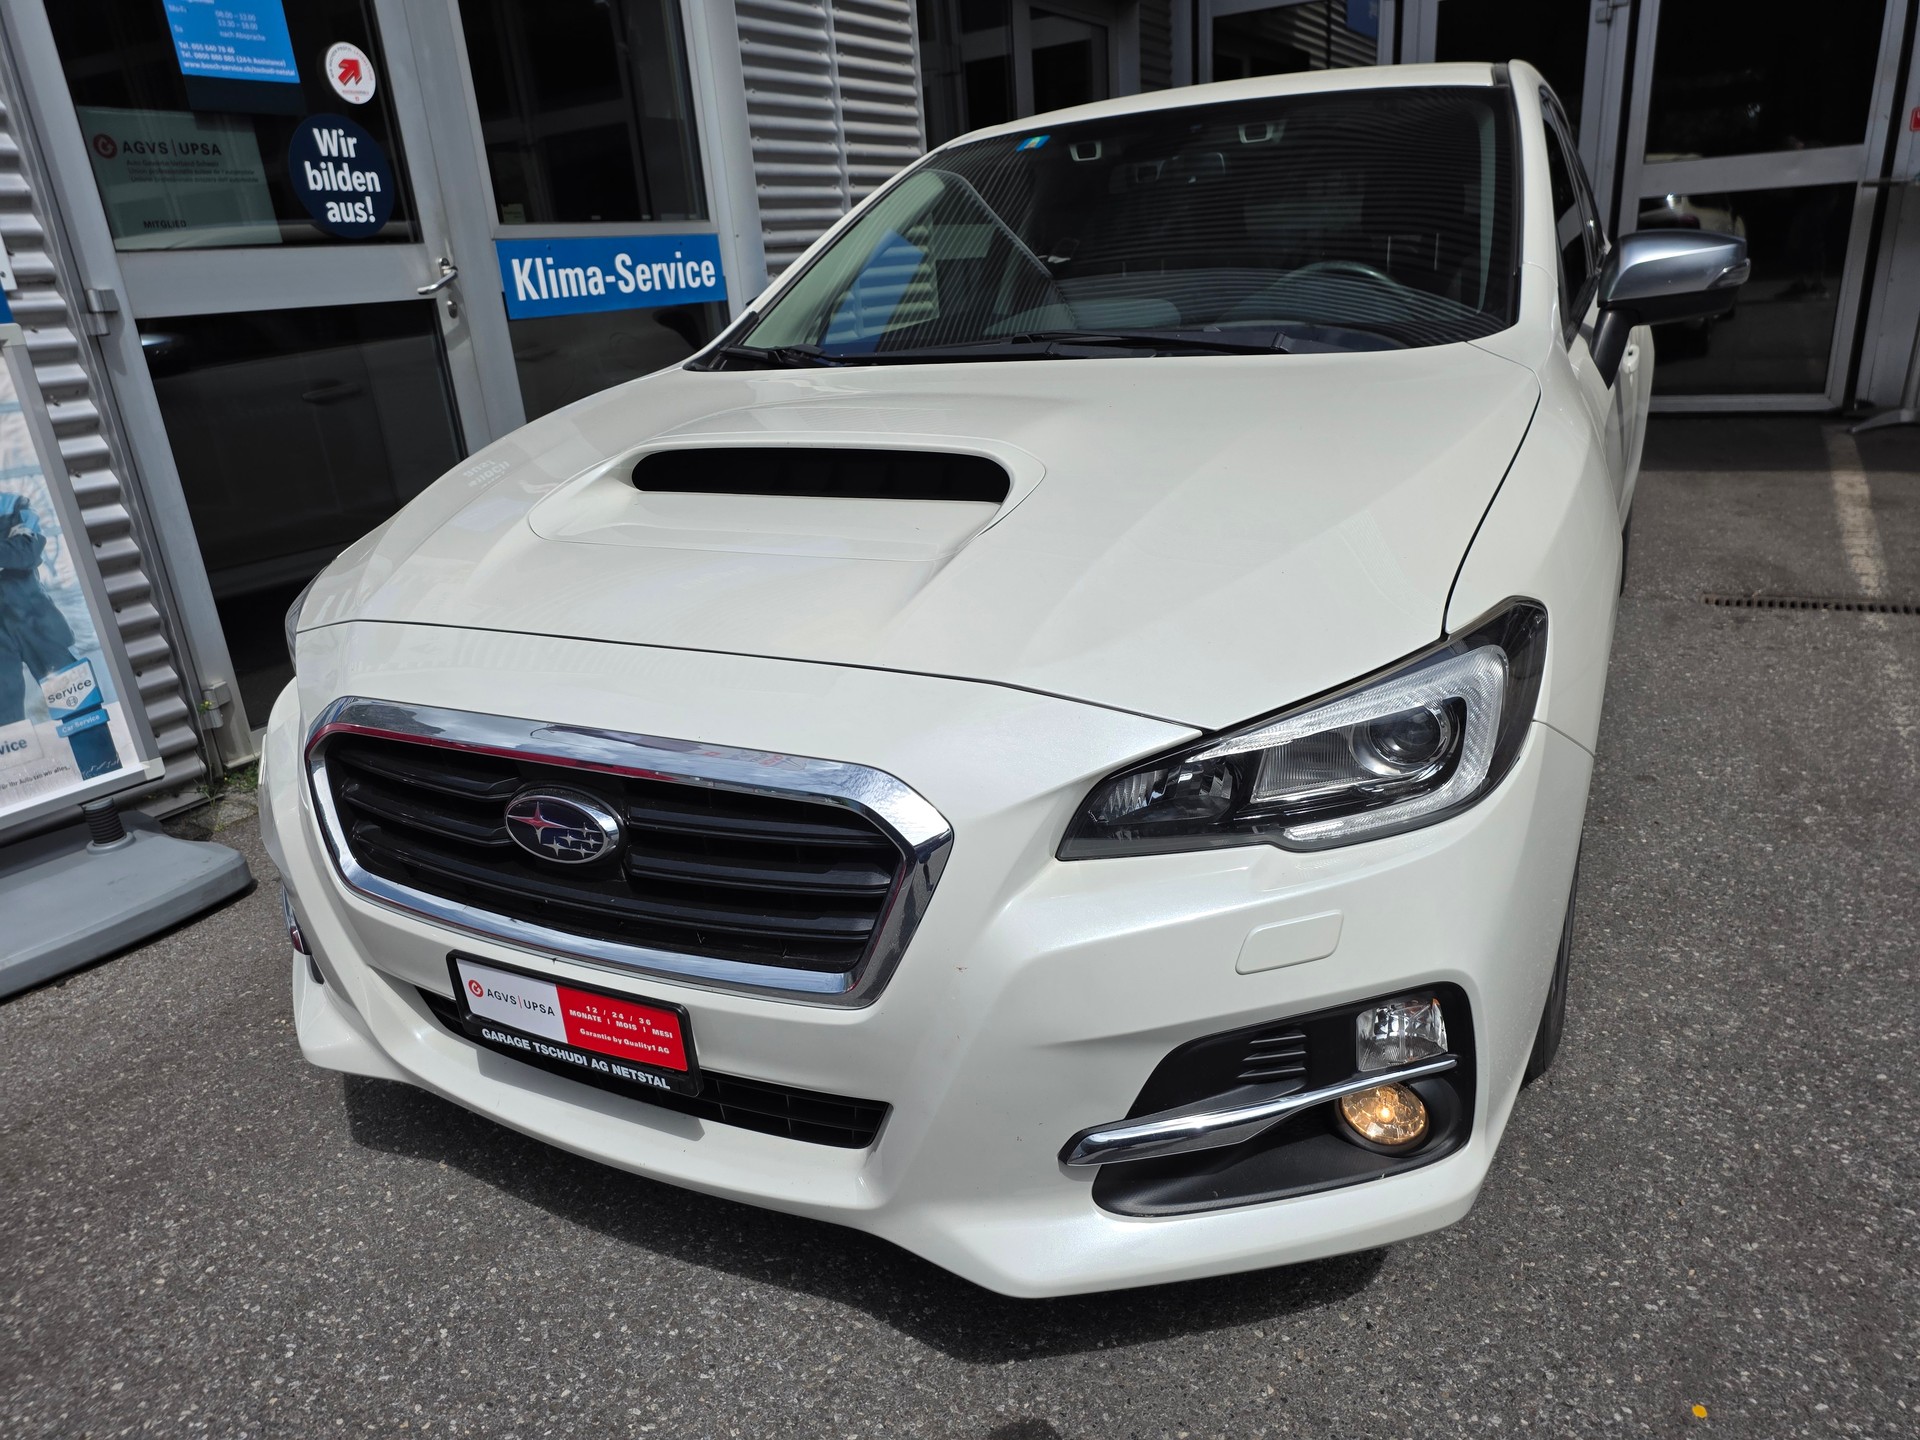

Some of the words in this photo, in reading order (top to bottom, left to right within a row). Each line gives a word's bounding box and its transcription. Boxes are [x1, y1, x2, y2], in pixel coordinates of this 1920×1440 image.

[122, 140, 168, 155] AGVS
[178, 142, 222, 156] UPSA
[312, 127, 357, 158] Wir
[304, 160, 381, 192] bilden
[326, 195, 376, 223] aus!
[143, 219, 187, 229] MITGLIED
[511, 251, 716, 302] Klima-Service
[47, 679, 92, 704] Service
[487, 988, 517, 1005] AGVS
[523, 999, 555, 1016] UPSA
[586, 1005, 598, 1014] 12
[638, 1017, 651, 1026] 36
[569, 1009, 602, 1023] MONATE
[616, 1020, 637, 1031] MOIS
[652, 1028, 673, 1038] MESI
[613, 1035, 622, 1044] by
[624, 1038, 656, 1052] Quality1
[657, 1046, 670, 1054] AG
[482, 1028, 531, 1050] GARAGE
[533, 1042, 588, 1066] TSCHUDI
[591, 1061, 609, 1072] AG
[612, 1064, 671, 1090] NETSTAL
